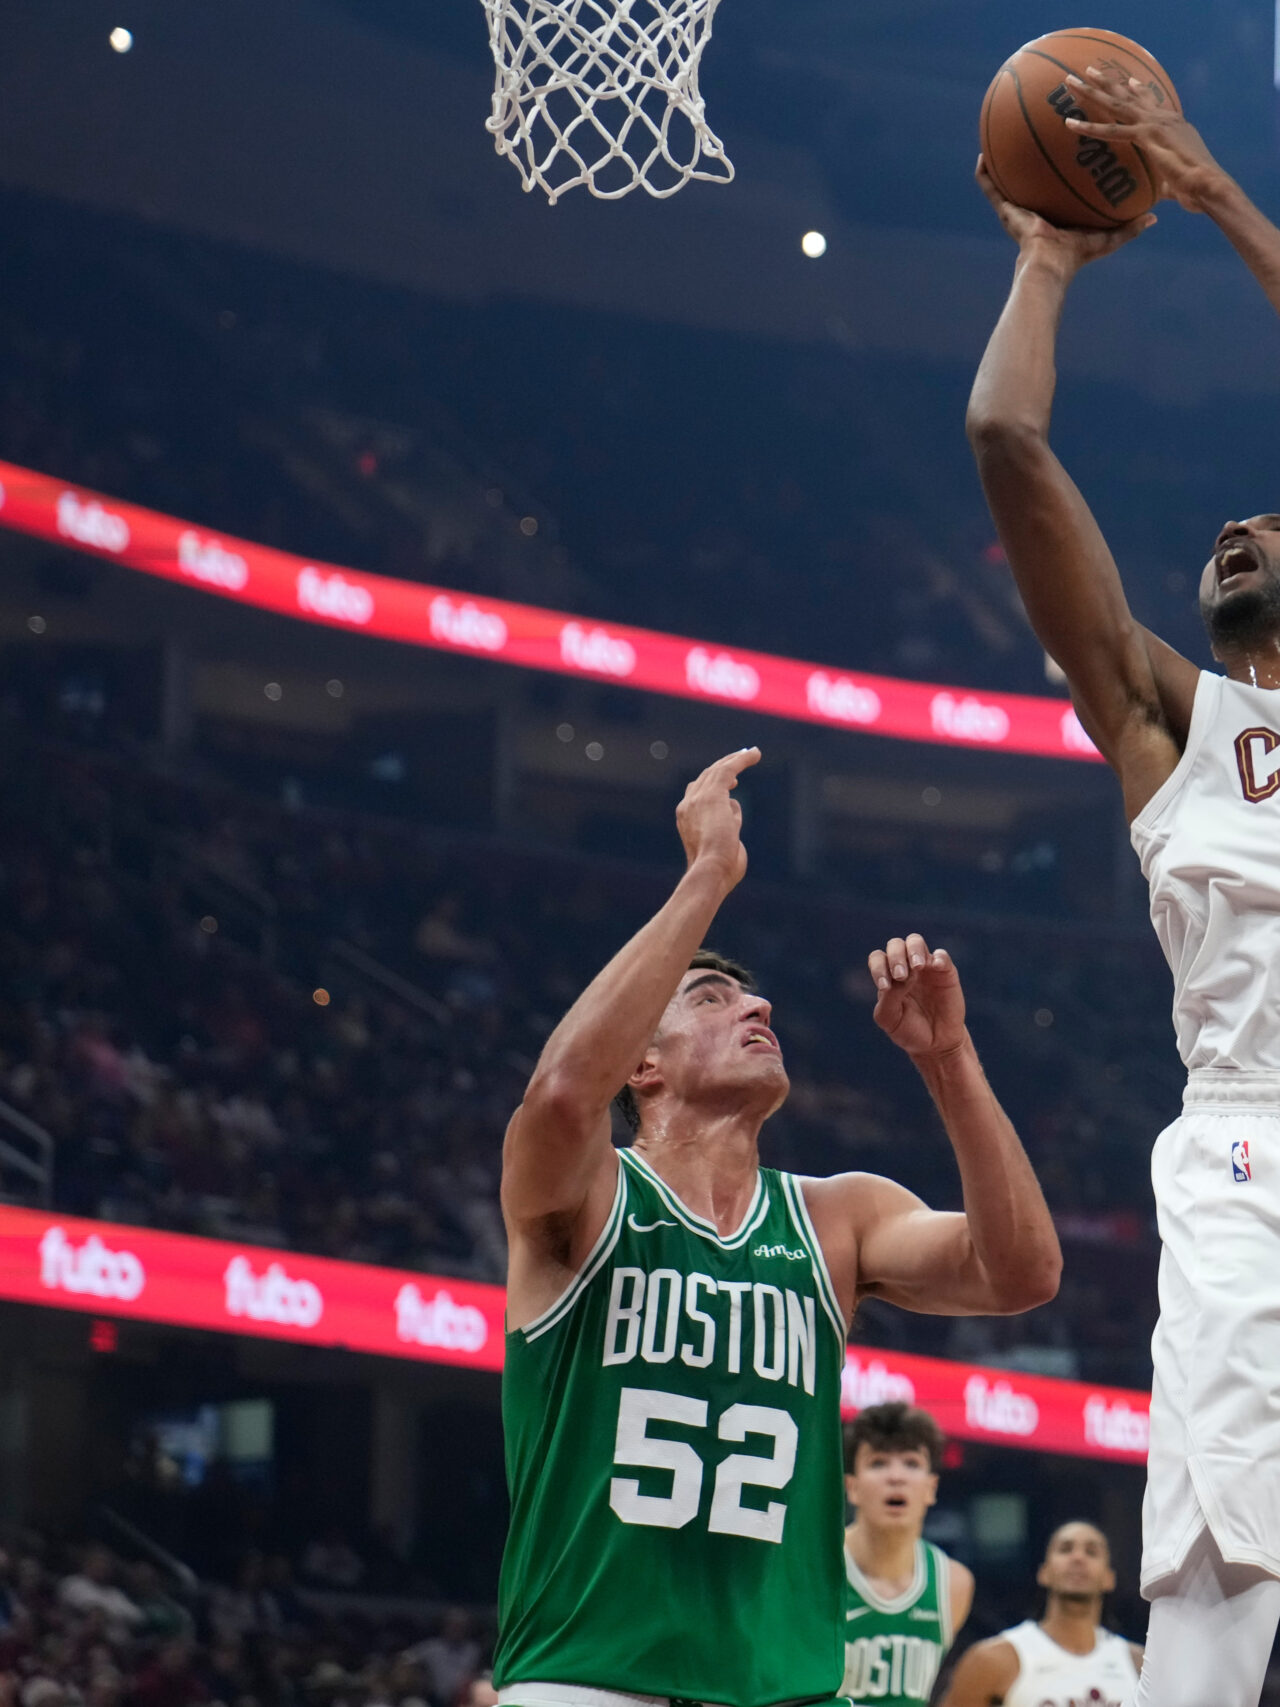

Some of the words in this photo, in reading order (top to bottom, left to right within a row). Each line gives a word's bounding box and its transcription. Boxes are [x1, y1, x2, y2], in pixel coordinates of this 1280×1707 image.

[1046, 82, 1138, 208] Wilon
[40, 1226, 144, 1301] fubo
[225, 1256, 323, 1327] fubo
[394, 1284, 487, 1352] fubo
[603, 1267, 816, 1396] BOSTON
[964, 1375, 1039, 1436] fubo
[610, 1387, 799, 1544] 52
